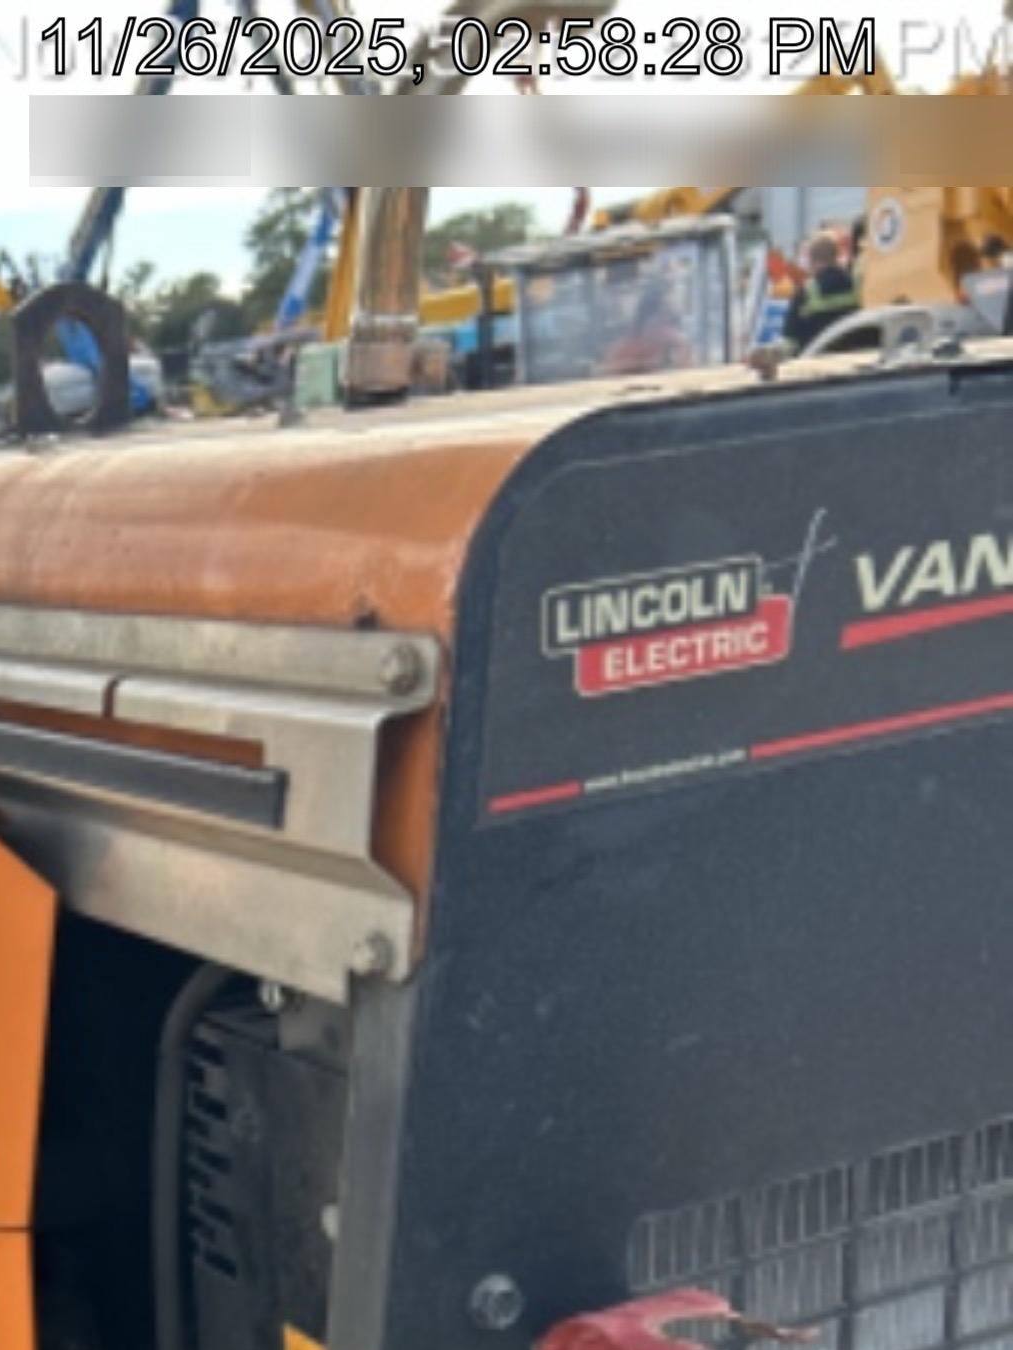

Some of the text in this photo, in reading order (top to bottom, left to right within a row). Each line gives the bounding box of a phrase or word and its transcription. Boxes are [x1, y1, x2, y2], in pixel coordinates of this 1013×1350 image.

[555, 566, 750, 645] LINCOLN
[854, 533, 1013, 612] VAN
[603, 623, 771, 682] ELECTRIC
